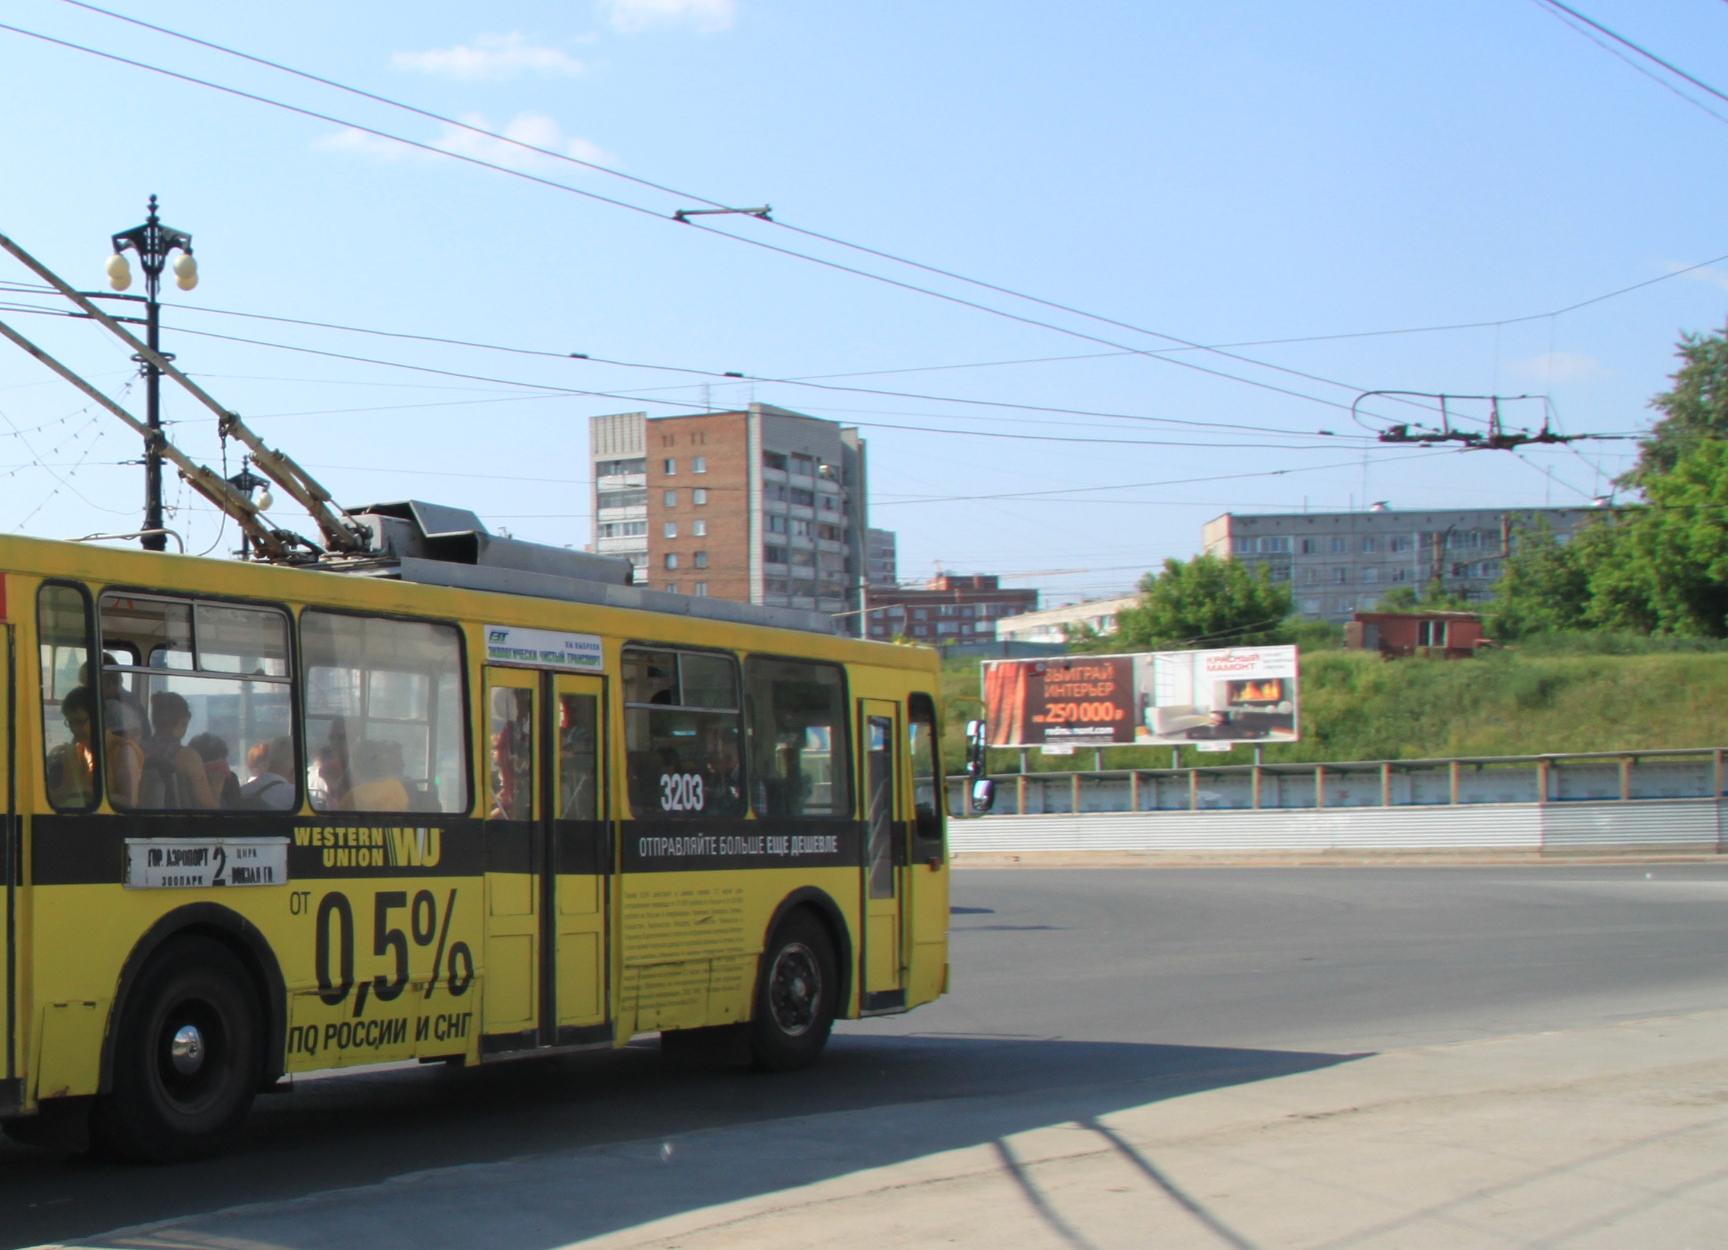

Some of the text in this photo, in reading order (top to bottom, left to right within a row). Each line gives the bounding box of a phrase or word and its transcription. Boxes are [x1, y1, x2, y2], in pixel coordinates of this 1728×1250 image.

[1080, 702, 1115, 721] 000
[660, 773, 703, 811] 3203
[294, 827, 384, 846] WESTERN
[639, 833, 838, 857] ОТПРАВЛЯЙТЕ БОЛЬШЕ ЕЩЕ ДЕШЕВЛЕ
[167, 848, 209, 866] АЭРОПОРТ
[212, 846, 226, 886] 2
[323, 848, 384, 867] UNION
[162, 875, 203, 886] ЗООПАРК
[290, 888, 474, 1018] ОТ 0,5%
[288, 1012, 473, 1056] ПО РОССИИ И СНГ
